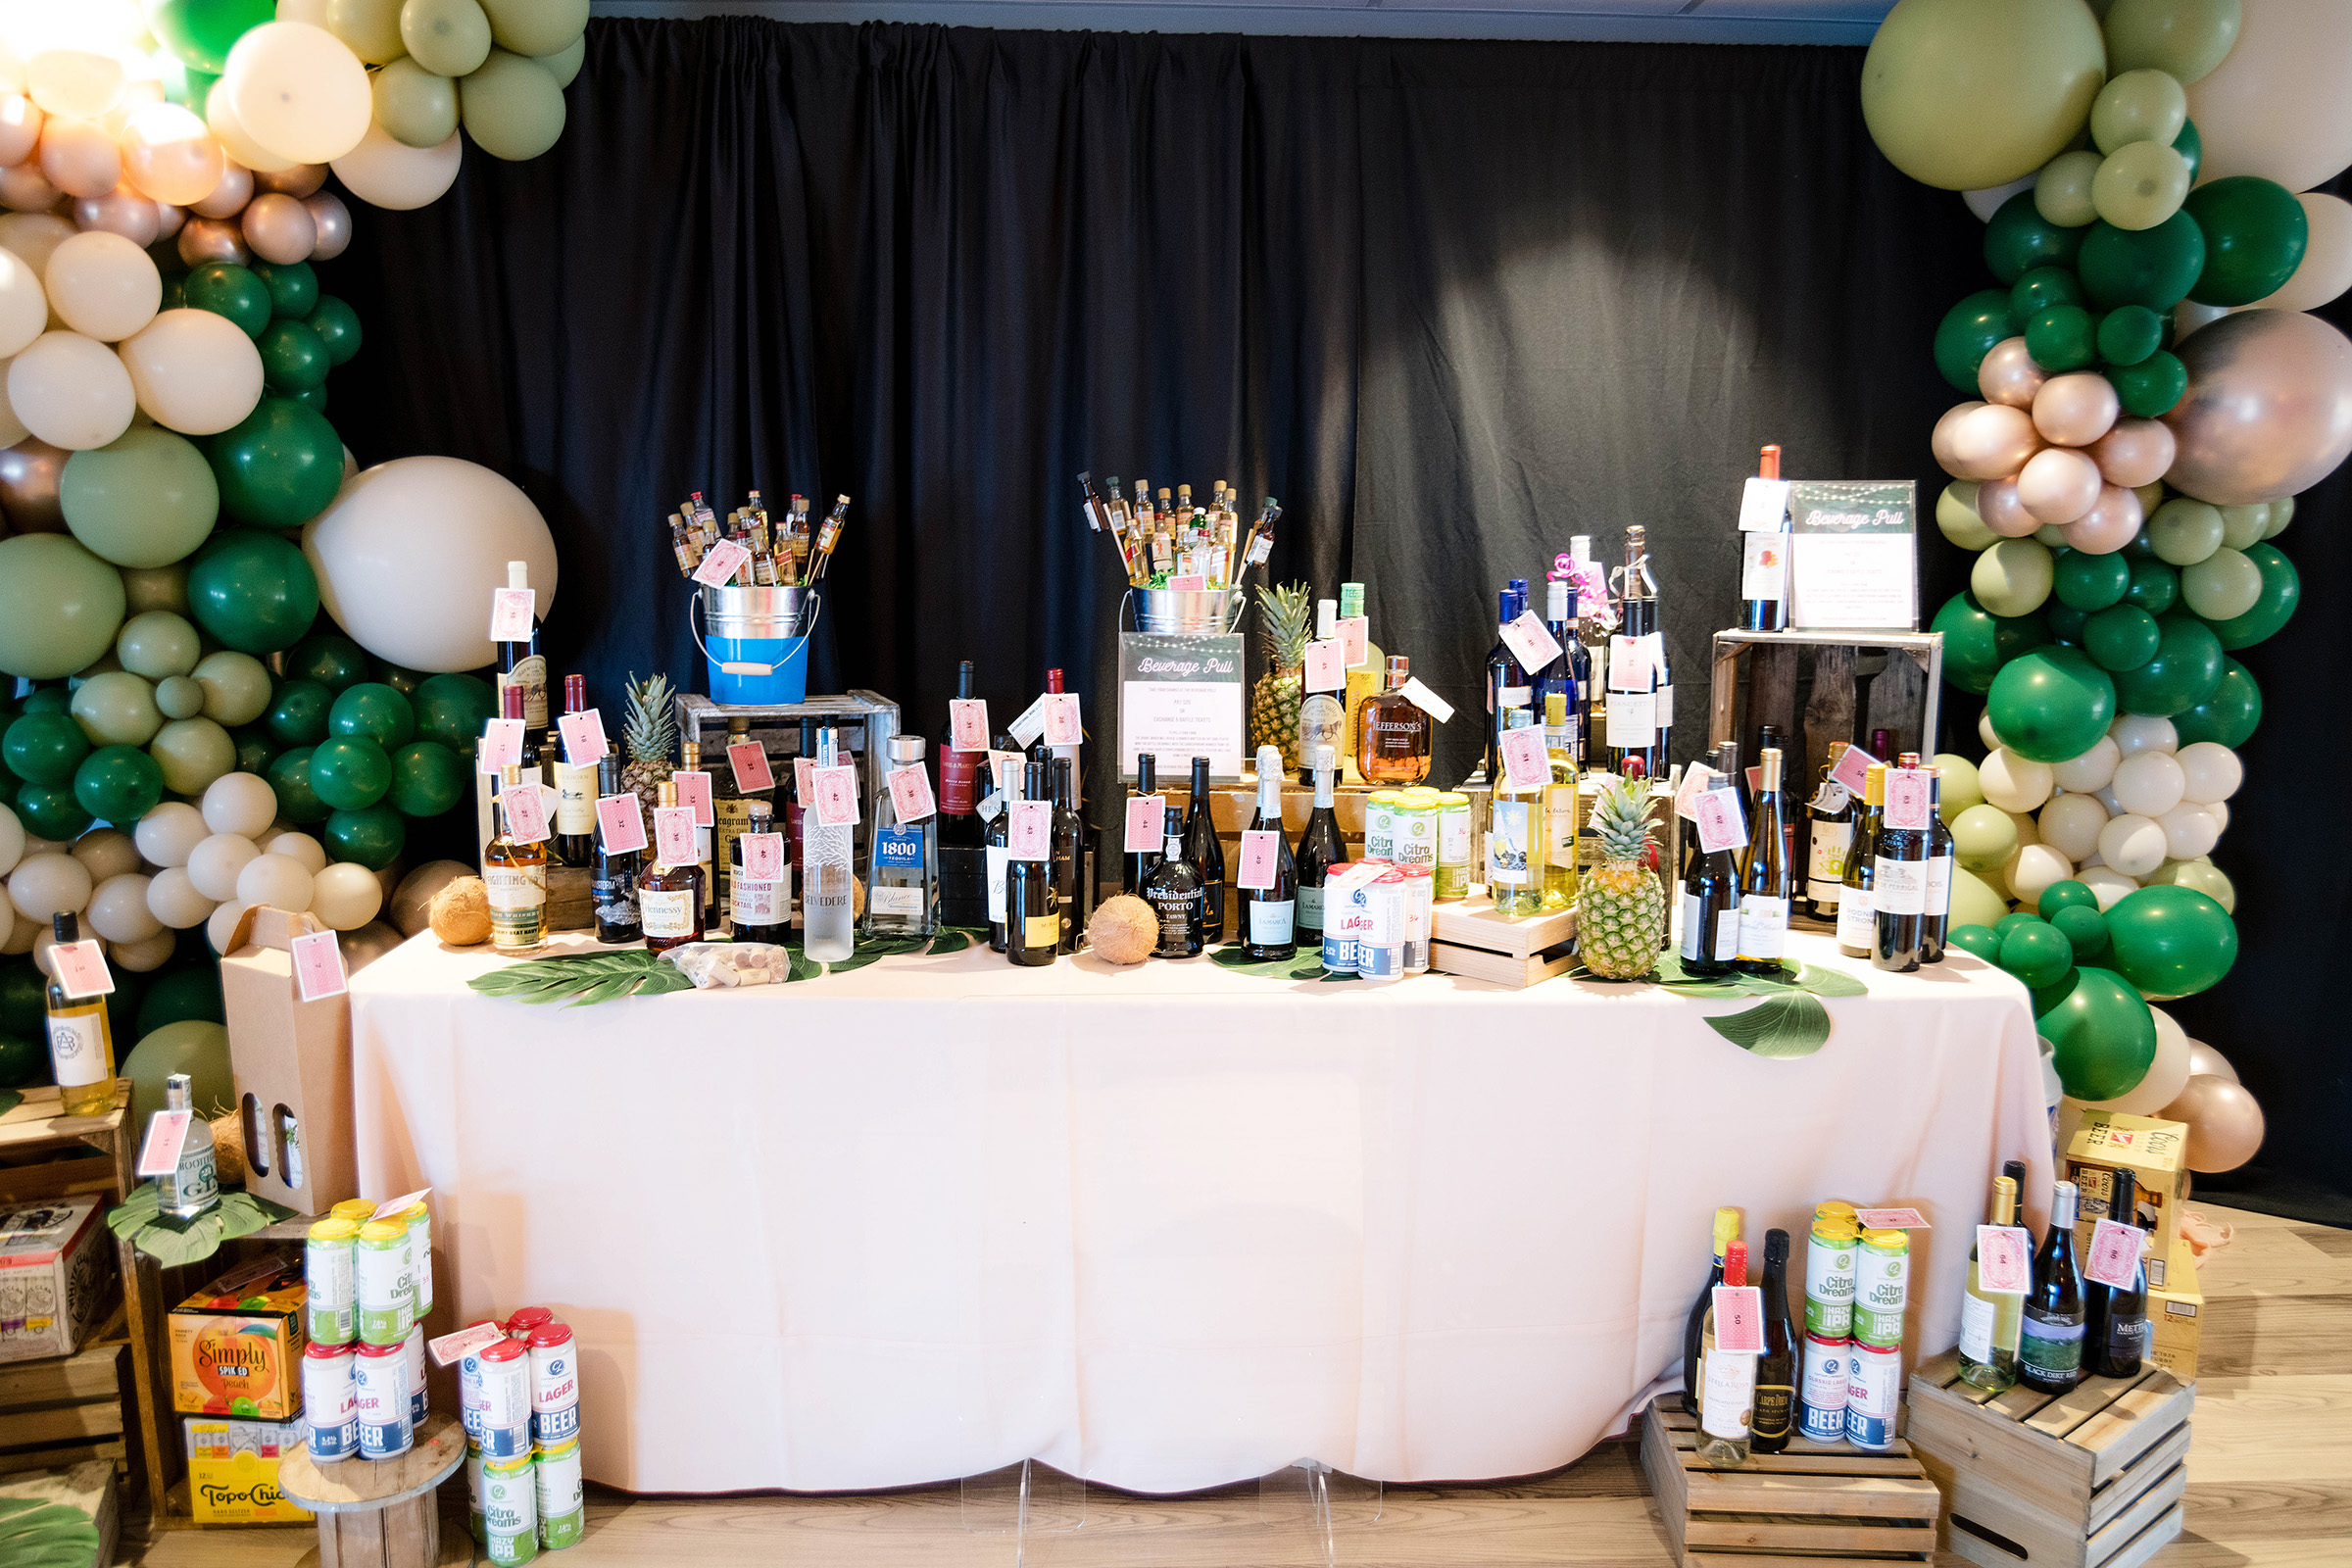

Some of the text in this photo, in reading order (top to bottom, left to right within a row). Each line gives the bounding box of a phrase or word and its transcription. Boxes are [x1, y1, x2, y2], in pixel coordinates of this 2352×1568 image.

[1805, 510, 1905, 529] Beverage Pull
[1138, 658, 1234, 676] Beverage Pull
[1372, 721, 1421, 731] JEFFERSON'S
[882, 841, 915, 857] 1800
[1403, 843, 1431, 855] Citra
[1398, 853, 1433, 864] Dreams
[737, 882, 772, 892] FASHIONED
[1147, 886, 1203, 900] Presidential
[806, 894, 847, 906] BELVEDERE
[1158, 902, 1194, 911] PORTO
[645, 903, 682, 915] Hennessy
[1846, 908, 1874, 917] RODNE
[1341, 915, 1360, 930] LAG
[1339, 941, 1358, 960] BE
[2087, 1121, 2110, 1147] BEER
[1827, 1276, 1853, 1288] Citra
[1827, 1305, 1851, 1314] HAZY
[1827, 1314, 1851, 1327] IPA
[1878, 1314, 1901, 1323] HAZY
[2164, 1313, 2174, 1323] 12
[1878, 1323, 1901, 1335] IPA
[199, 1339, 270, 1373] Simply
[218, 1366, 248, 1376] SPIKED
[1707, 1377, 1750, 1390] STELLA ROSA
[539, 1379, 574, 1403] LAGER
[540, 1407, 577, 1433] BEER
[1808, 1407, 1842, 1429] BEER
[342, 1421, 360, 1446] BE
[200, 1484, 286, 1507] Topo Chic
[492, 1544, 514, 1557] IPA
